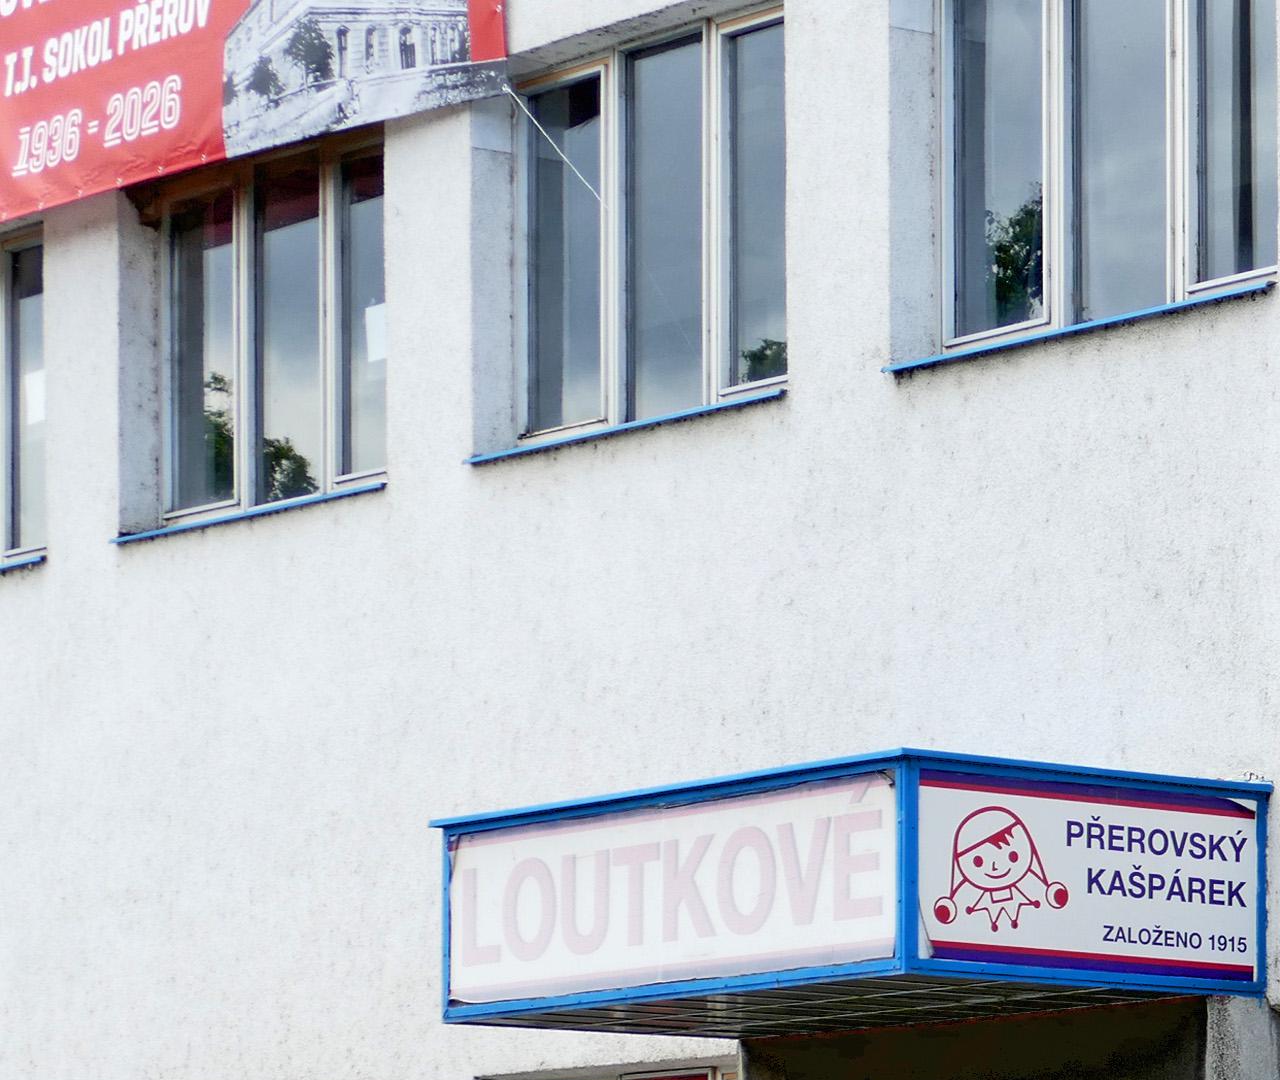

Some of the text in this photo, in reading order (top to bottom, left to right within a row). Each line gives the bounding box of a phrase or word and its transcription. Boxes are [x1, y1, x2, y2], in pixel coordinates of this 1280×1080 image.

[4, 46, 38, 97] T.J.
[42, 17, 113, 84] SOKOL
[11, 108, 82, 178] 1936
[104, 74, 181, 148] 2026
[1066, 815, 1248, 863] PŘEROVSKÝ
[461, 780, 884, 968] LOUTKOVÉ
[1087, 864, 1248, 908] KAŠPÁREK
[1102, 924, 1248, 953] ZALOŽENO 1915
